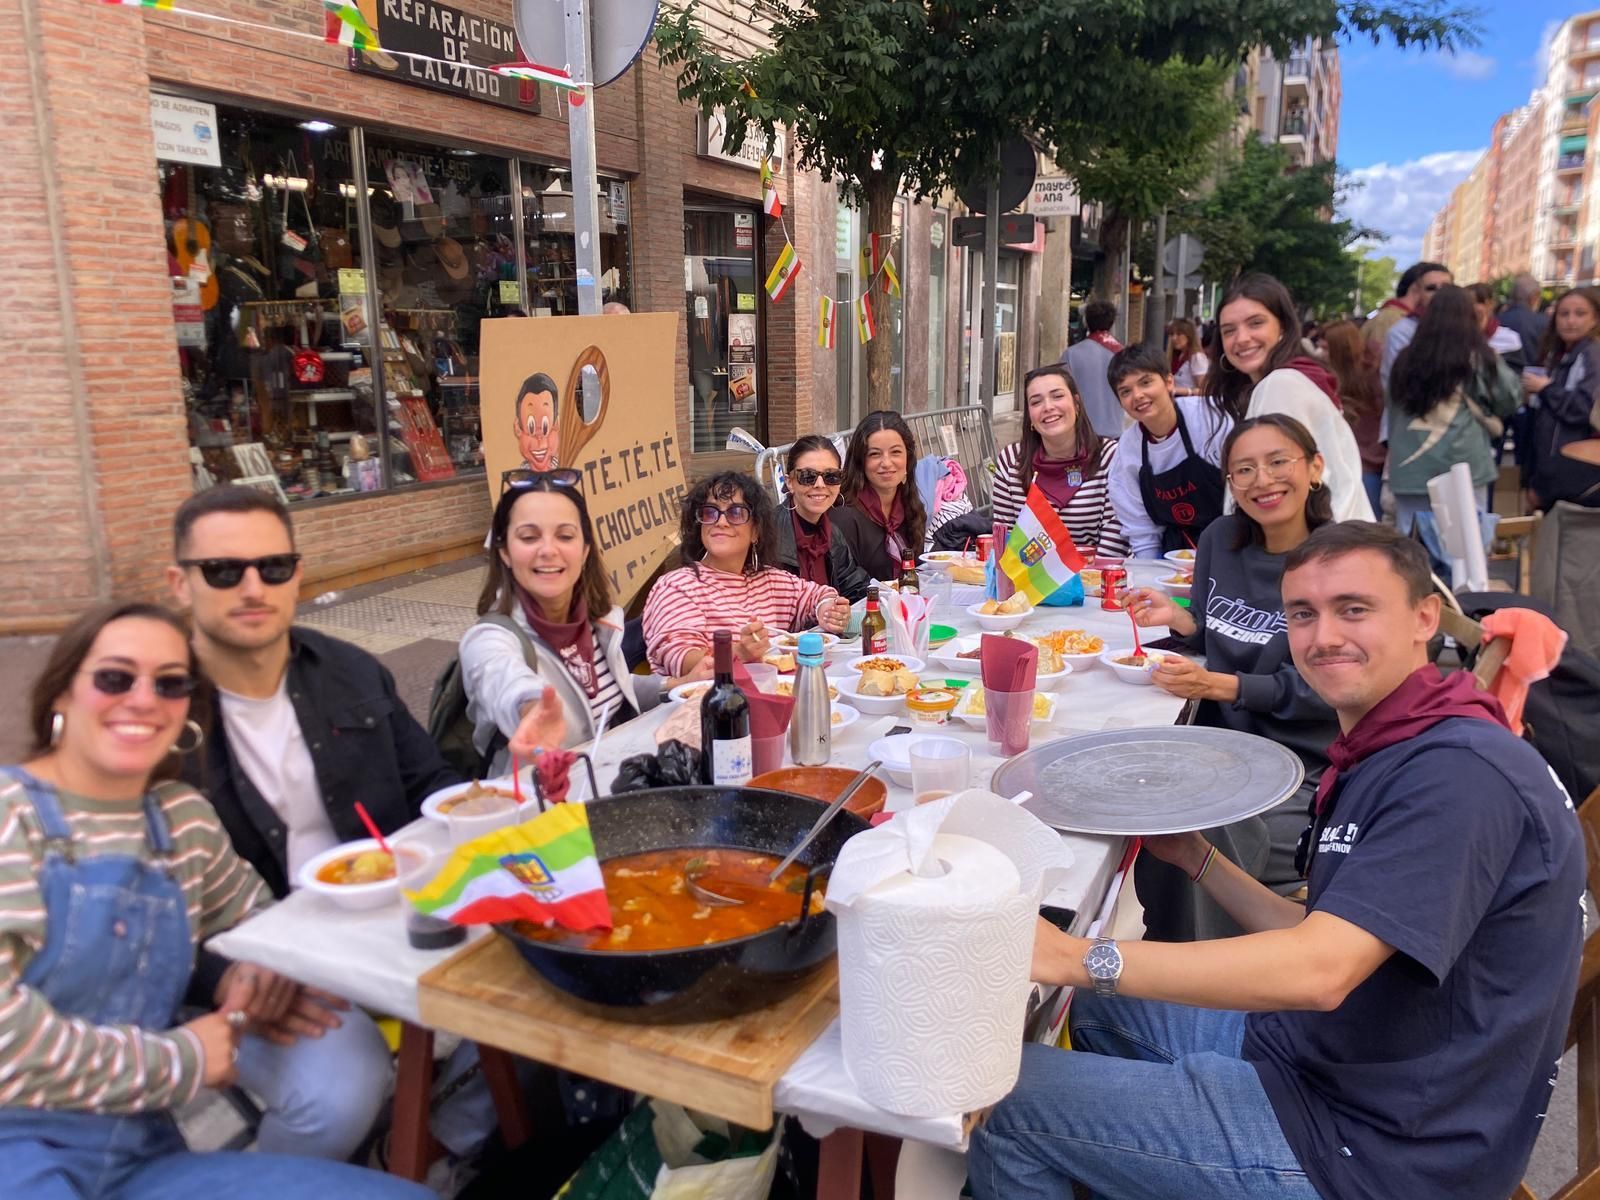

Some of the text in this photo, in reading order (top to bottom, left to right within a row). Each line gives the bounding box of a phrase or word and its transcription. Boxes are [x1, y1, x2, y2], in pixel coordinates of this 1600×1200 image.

[383, 0, 514, 53] REPARACIÓN
[443, 36, 470, 64] DE
[172, 102, 210, 117] ADMITEN
[156, 142, 175, 152] CON
[1153, 480, 1198, 500] PAULA
